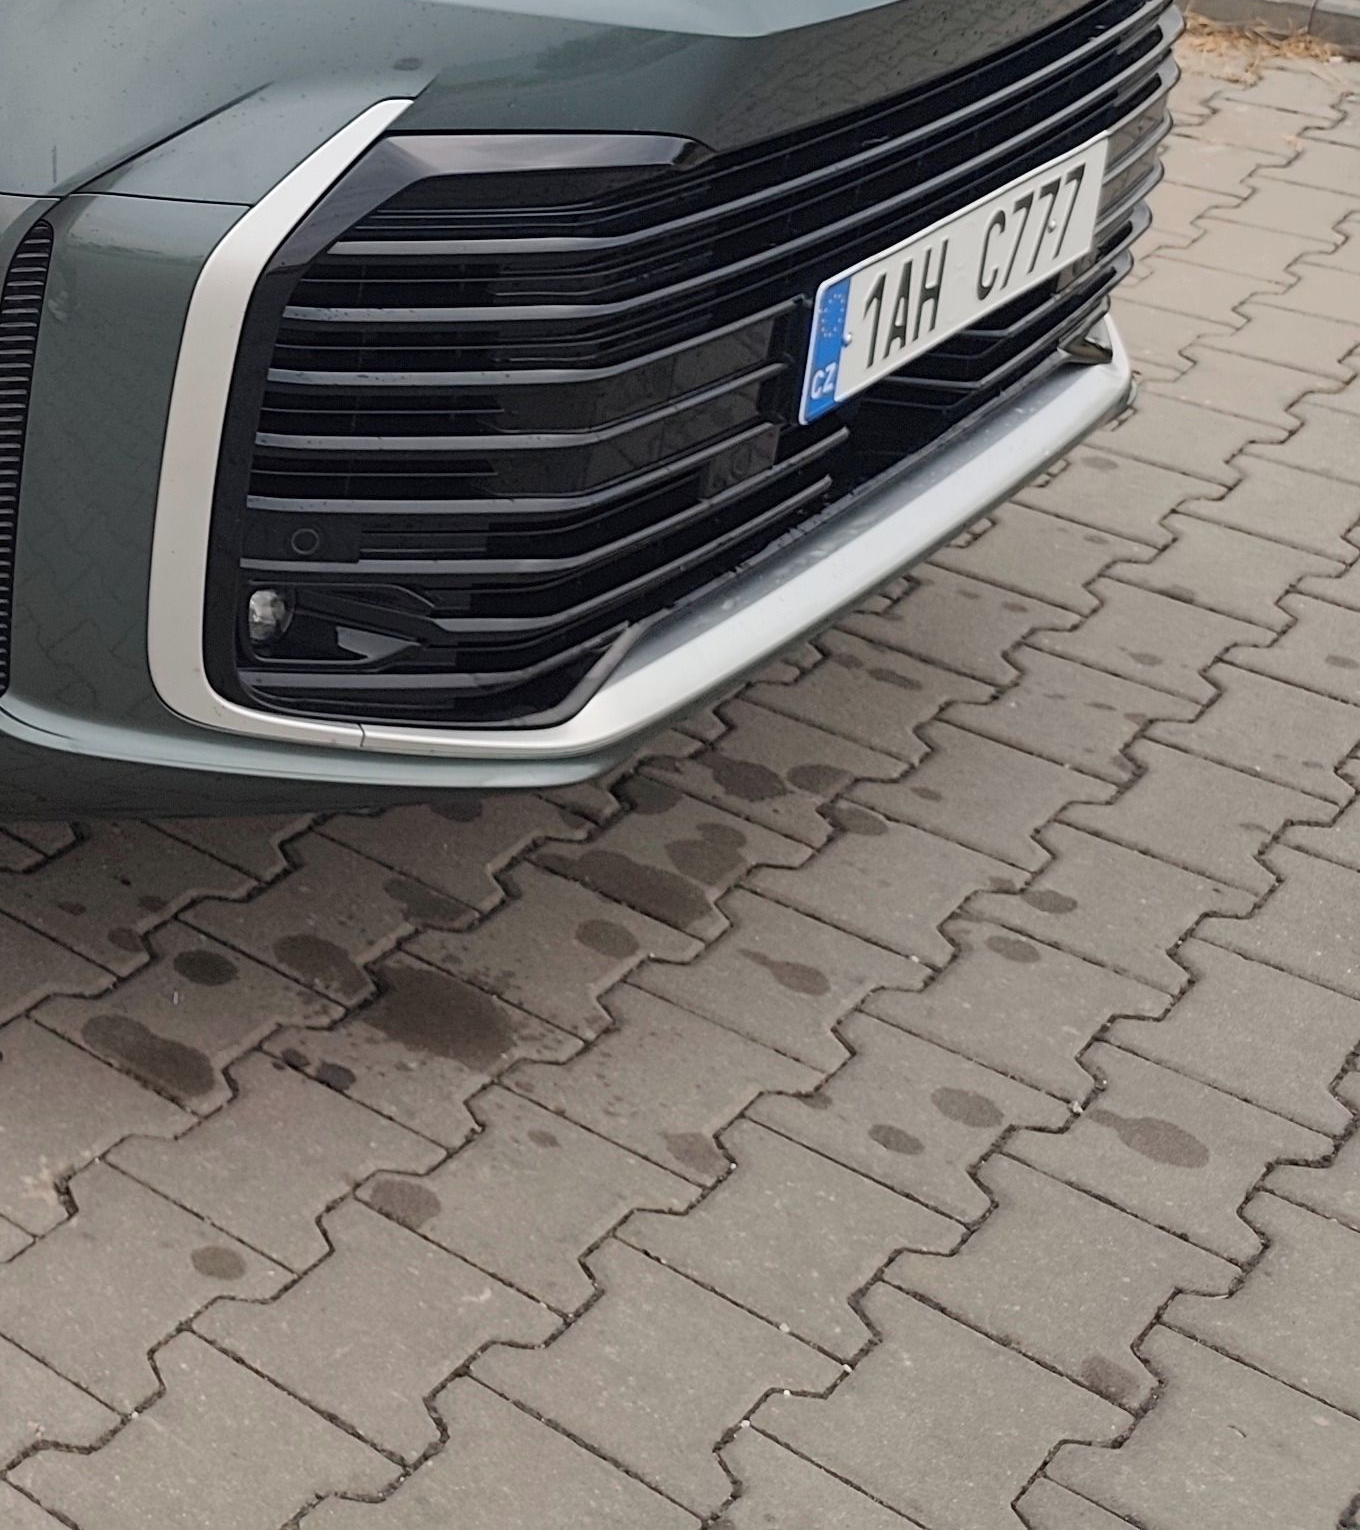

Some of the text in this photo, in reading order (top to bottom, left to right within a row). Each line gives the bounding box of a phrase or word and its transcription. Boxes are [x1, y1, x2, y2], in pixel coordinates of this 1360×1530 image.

[863, 162, 1086, 368] 1AH C777
[810, 362, 836, 400] CZ
